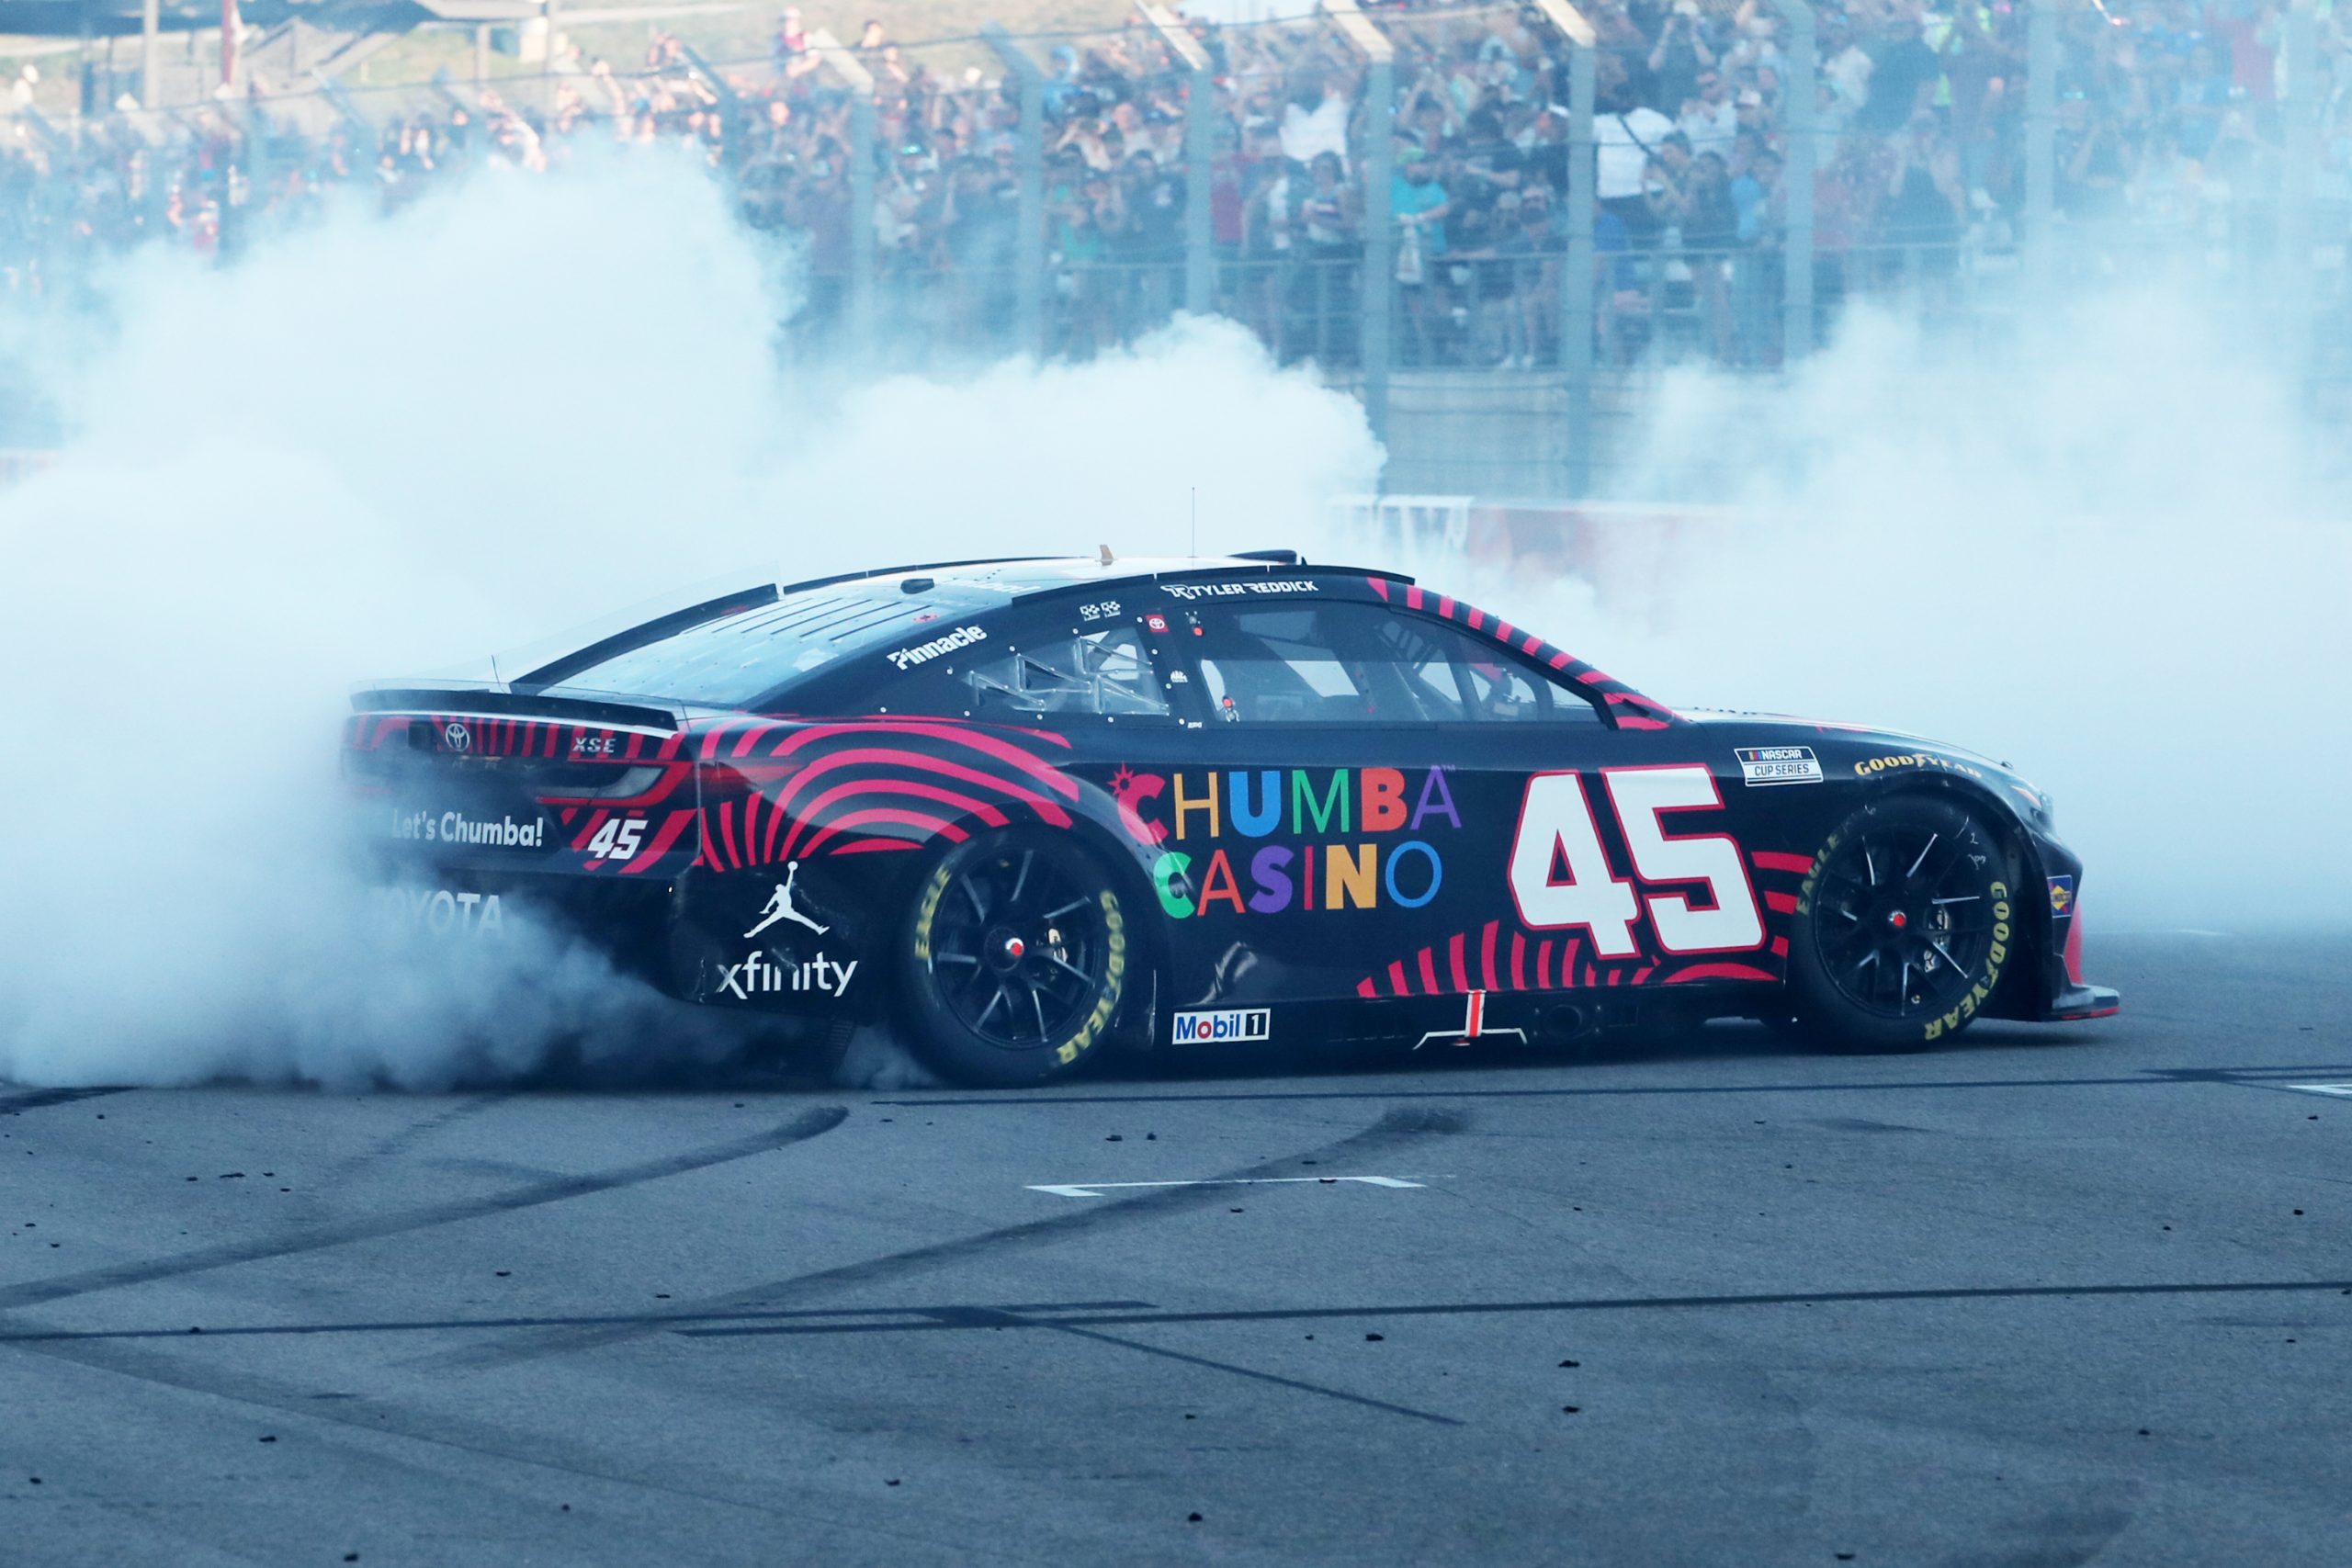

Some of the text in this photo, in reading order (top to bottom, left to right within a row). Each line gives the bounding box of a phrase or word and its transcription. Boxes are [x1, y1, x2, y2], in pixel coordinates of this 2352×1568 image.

[1190, 582, 1246, 596] TYLER
[1243, 581, 1318, 594] REDDICK
[887, 624, 988, 671] Pinnacle
[572, 737, 616, 753] XSE
[1761, 749, 1803, 761] NASCAR
[1854, 752, 1983, 779] GOODYEAR
[1754, 762, 1810, 776] CUP SERIES
[1108, 763, 1463, 845] CHUMBA
[392, 808, 544, 847] Let's Chumba!
[587, 818, 649, 860] 45
[1153, 840, 1442, 919] CASINO
[1507, 762, 1767, 961] 45
[716, 951, 858, 999] xfinity
[1056, 889, 1125, 1065] GOODYEAR
[1924, 881, 2010, 1040] GOODYEAR
[1176, 1014, 1260, 1040] Mobil 1
